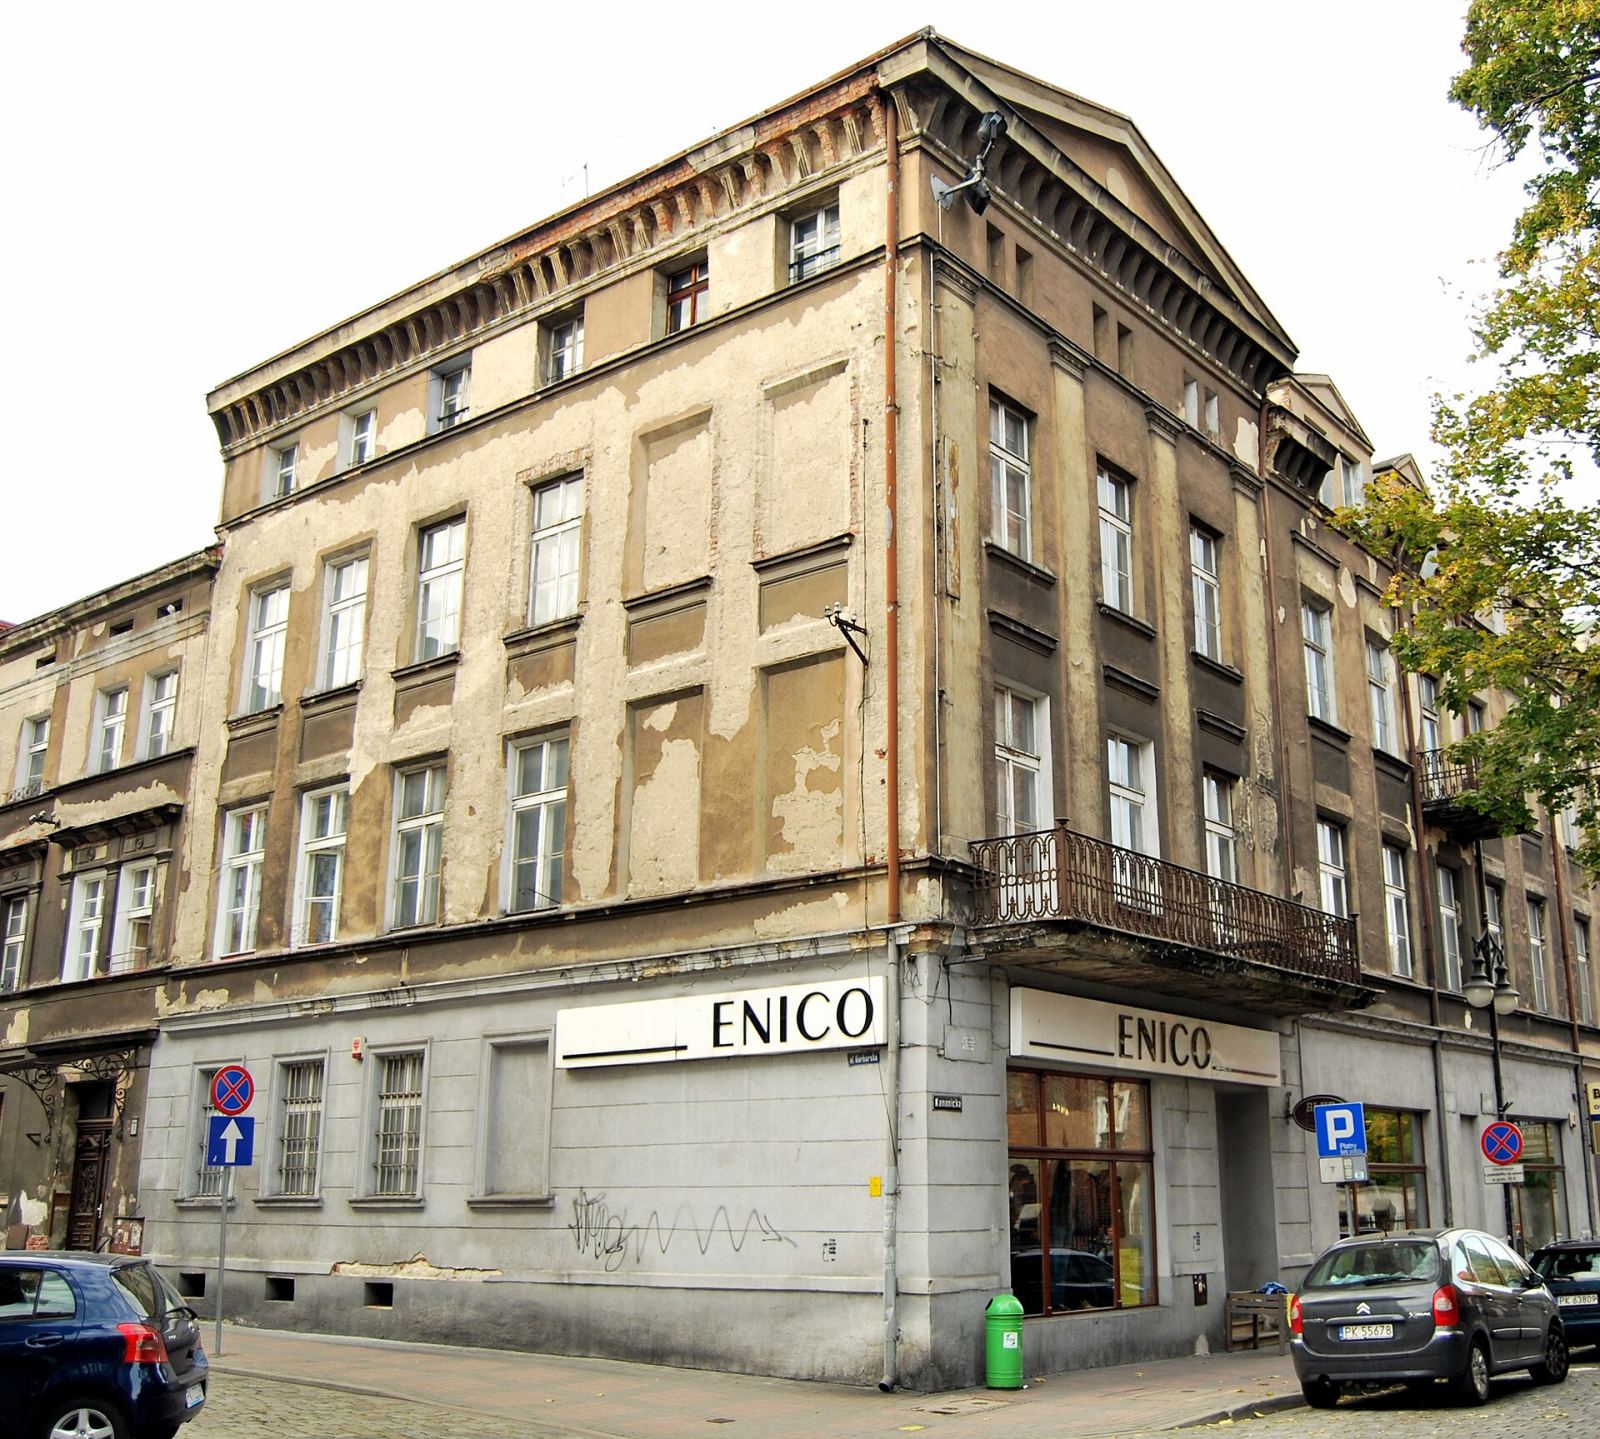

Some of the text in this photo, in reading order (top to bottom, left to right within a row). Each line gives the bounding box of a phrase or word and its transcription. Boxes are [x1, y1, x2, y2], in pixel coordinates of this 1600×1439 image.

[713, 988, 874, 1047] ENICO
[1118, 1014, 1211, 1069] ENICO
[1326, 1109, 1354, 1150] P
[1345, 1325, 1391, 1336] PK 55678
